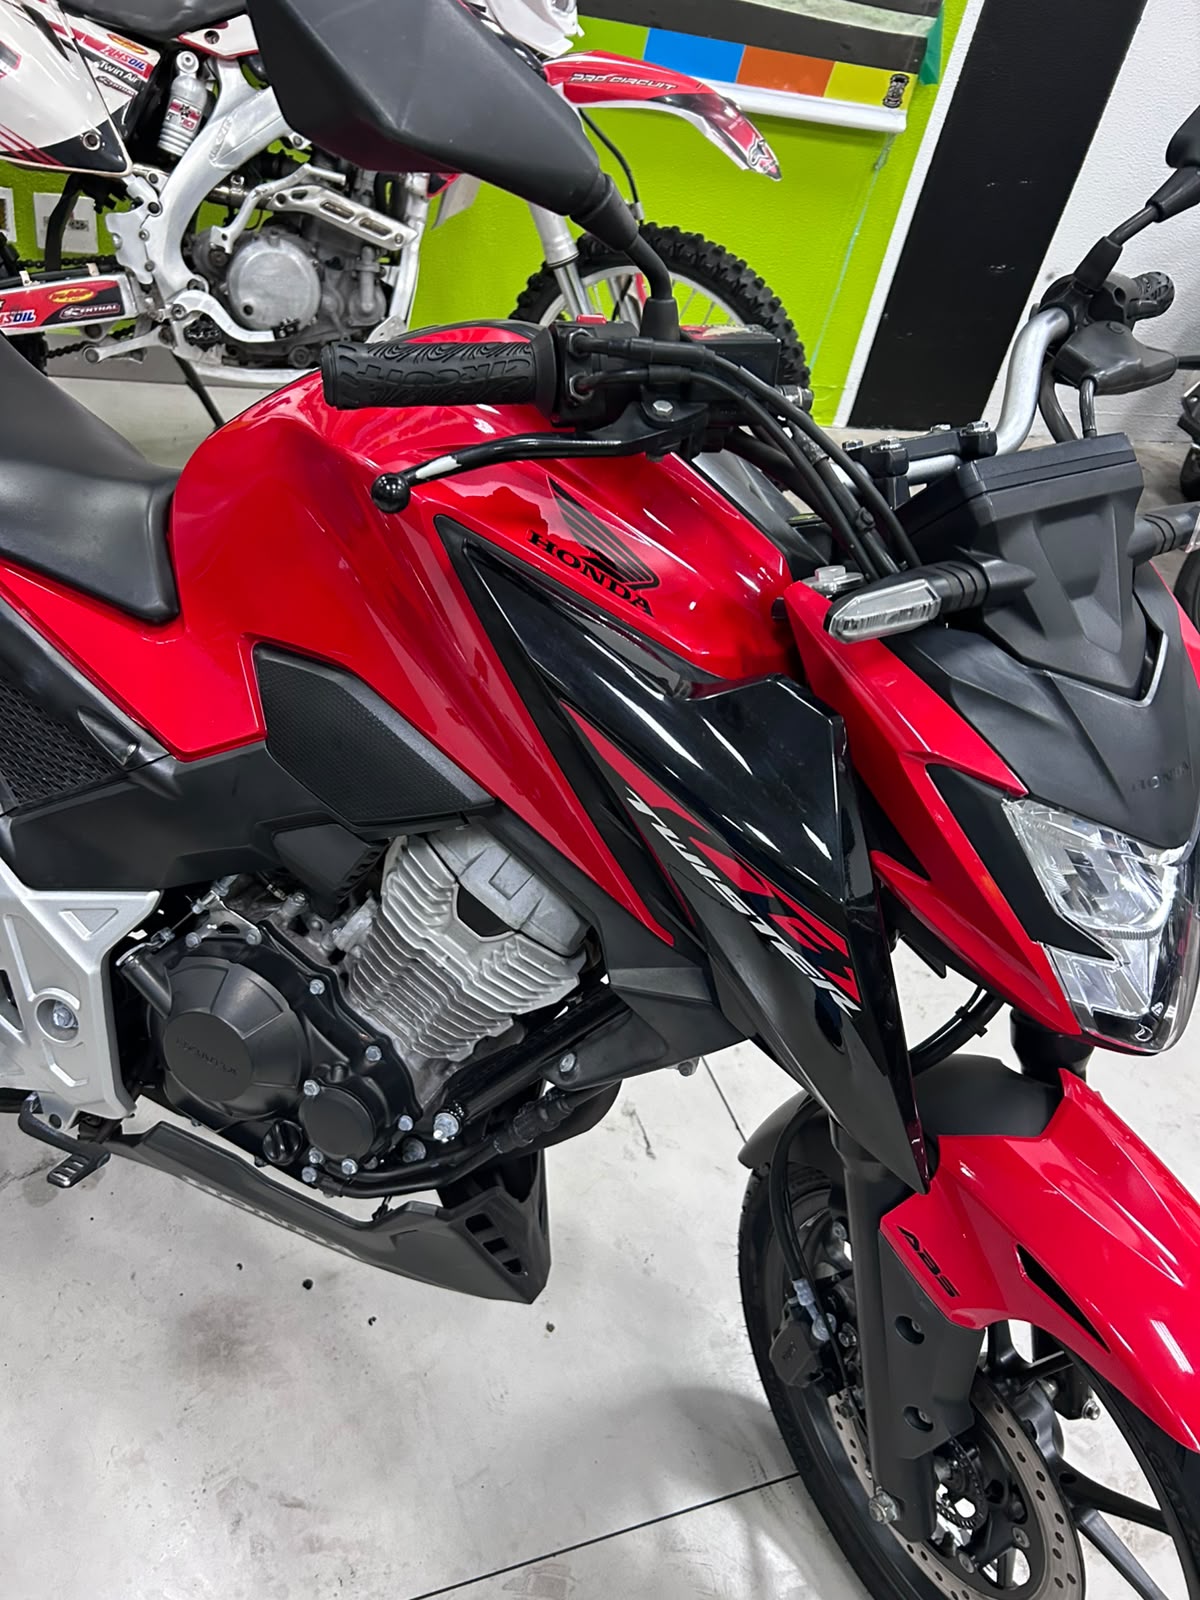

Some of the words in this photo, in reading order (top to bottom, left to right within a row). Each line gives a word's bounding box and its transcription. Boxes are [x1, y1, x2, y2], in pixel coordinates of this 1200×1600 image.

[100, 60, 124, 78] Twin
[123, 72, 141, 84] Air
[103, 46, 146, 71] AMSOIL
[570, 73, 608, 83] PRO
[609, 76, 677, 91] CIRCUIT
[527, 530, 655, 619] HONDA
[624, 786, 862, 1019] TWISTER
[896, 1225, 961, 1298] ABS
